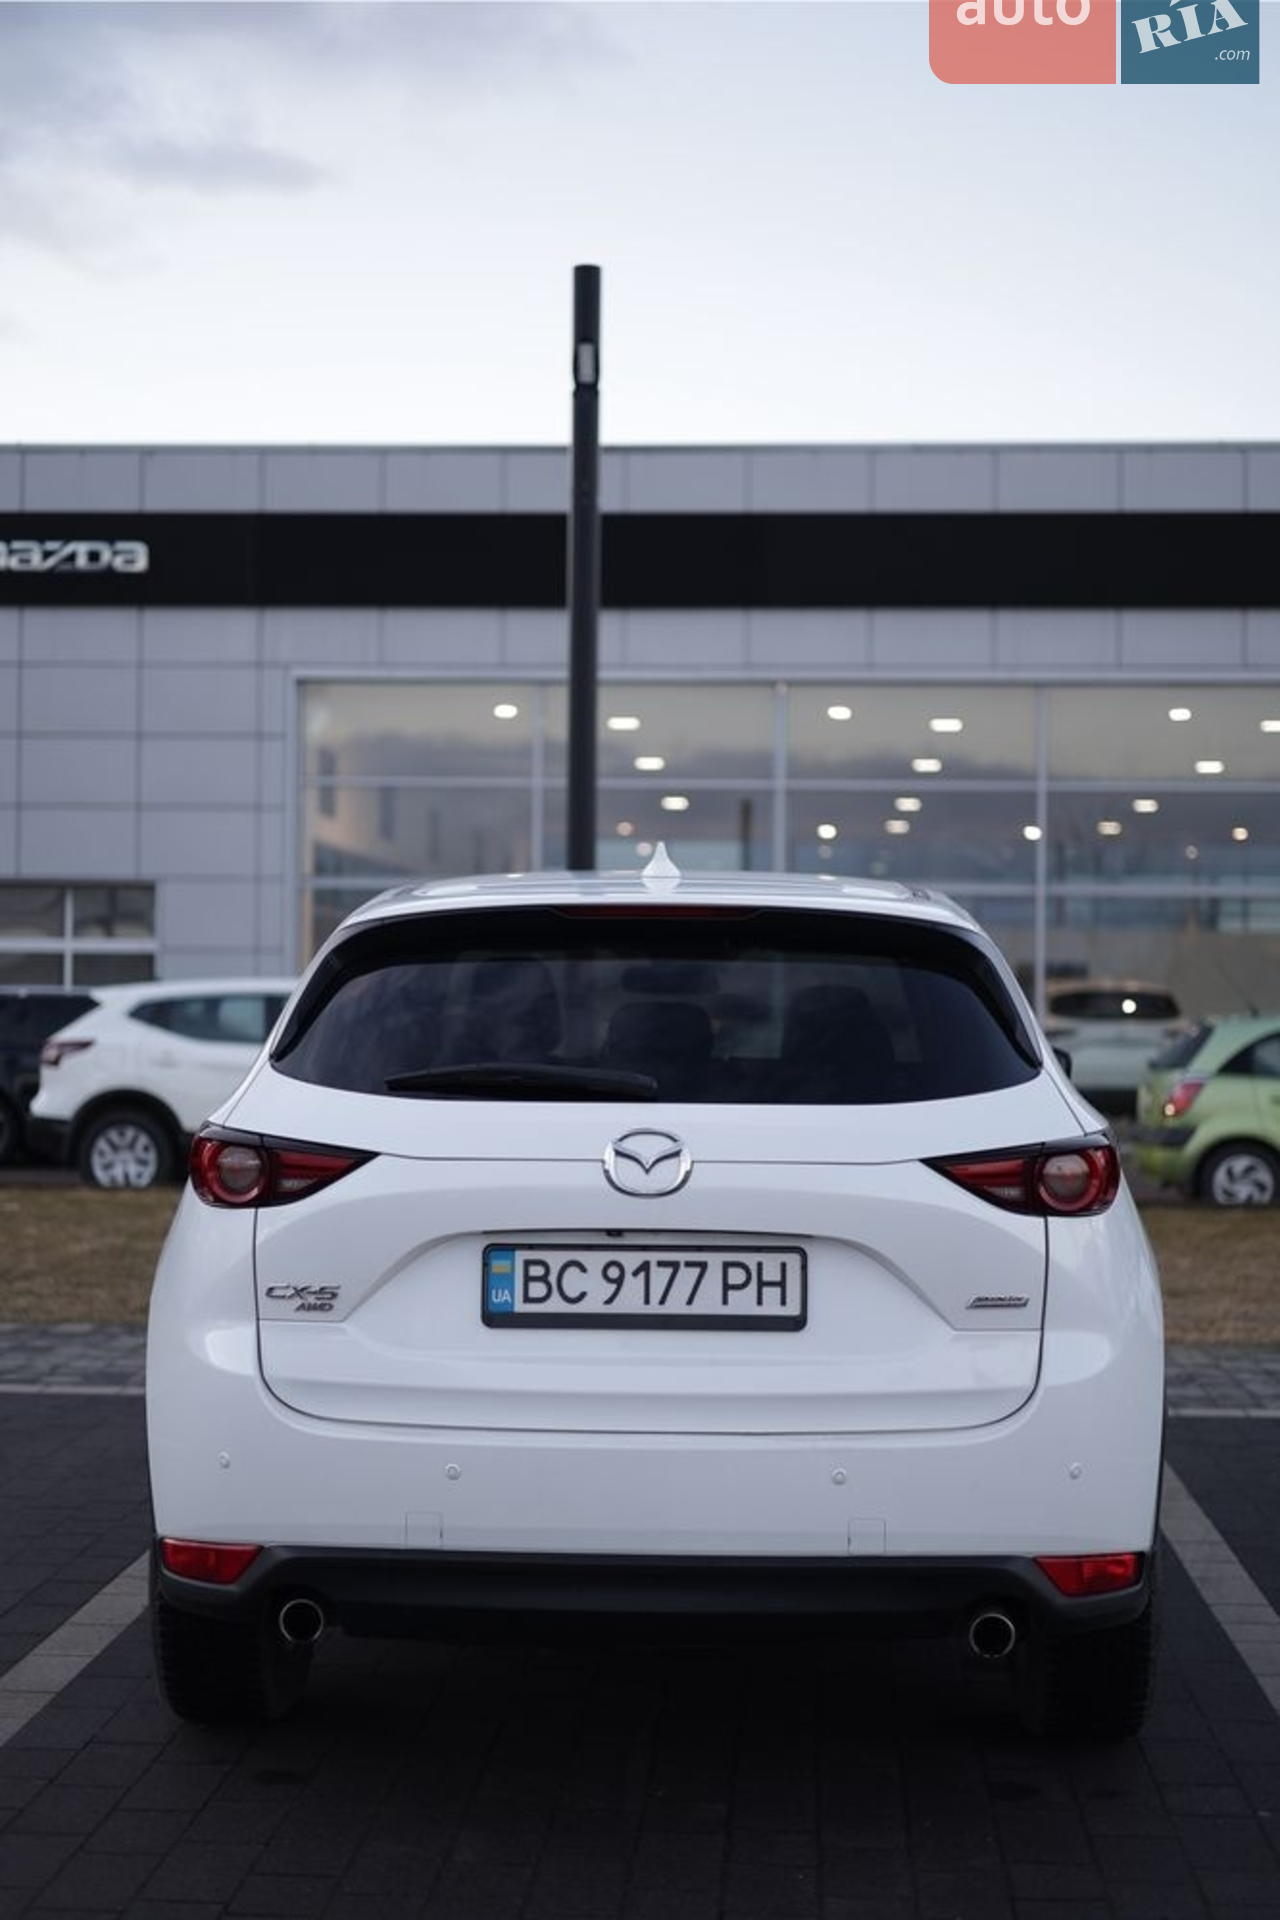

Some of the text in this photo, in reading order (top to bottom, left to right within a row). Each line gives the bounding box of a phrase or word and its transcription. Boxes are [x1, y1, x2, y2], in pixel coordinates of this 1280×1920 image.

[0, 540, 149, 573] azda
[265, 1284, 341, 1301] CX-5
[522, 1258, 788, 1307] BC 9177 PH
[491, 1289, 512, 1303] UA
